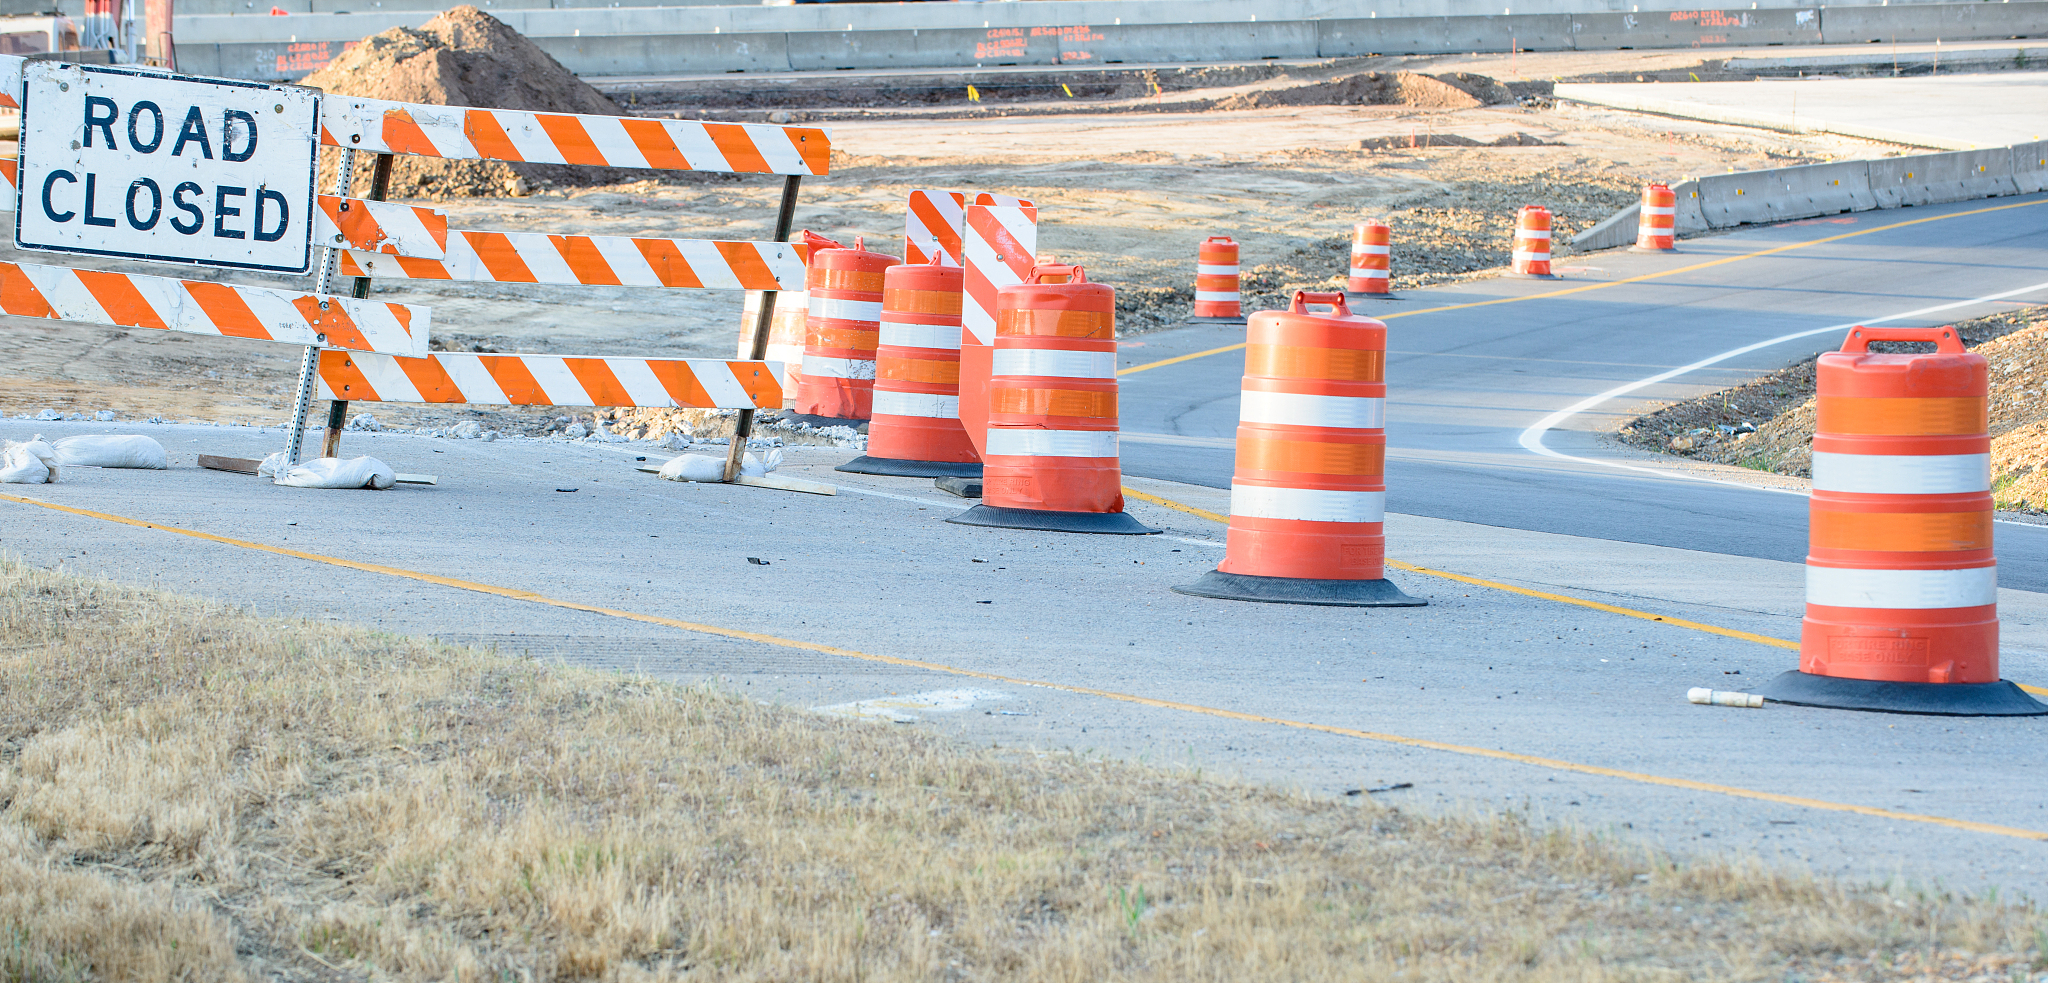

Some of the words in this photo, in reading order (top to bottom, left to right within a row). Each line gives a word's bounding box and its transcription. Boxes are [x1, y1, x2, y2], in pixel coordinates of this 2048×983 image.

[83, 95, 258, 163] ROAD
[42, 169, 290, 242] CLOSED
[1876, 652, 1913, 663] ONLY
